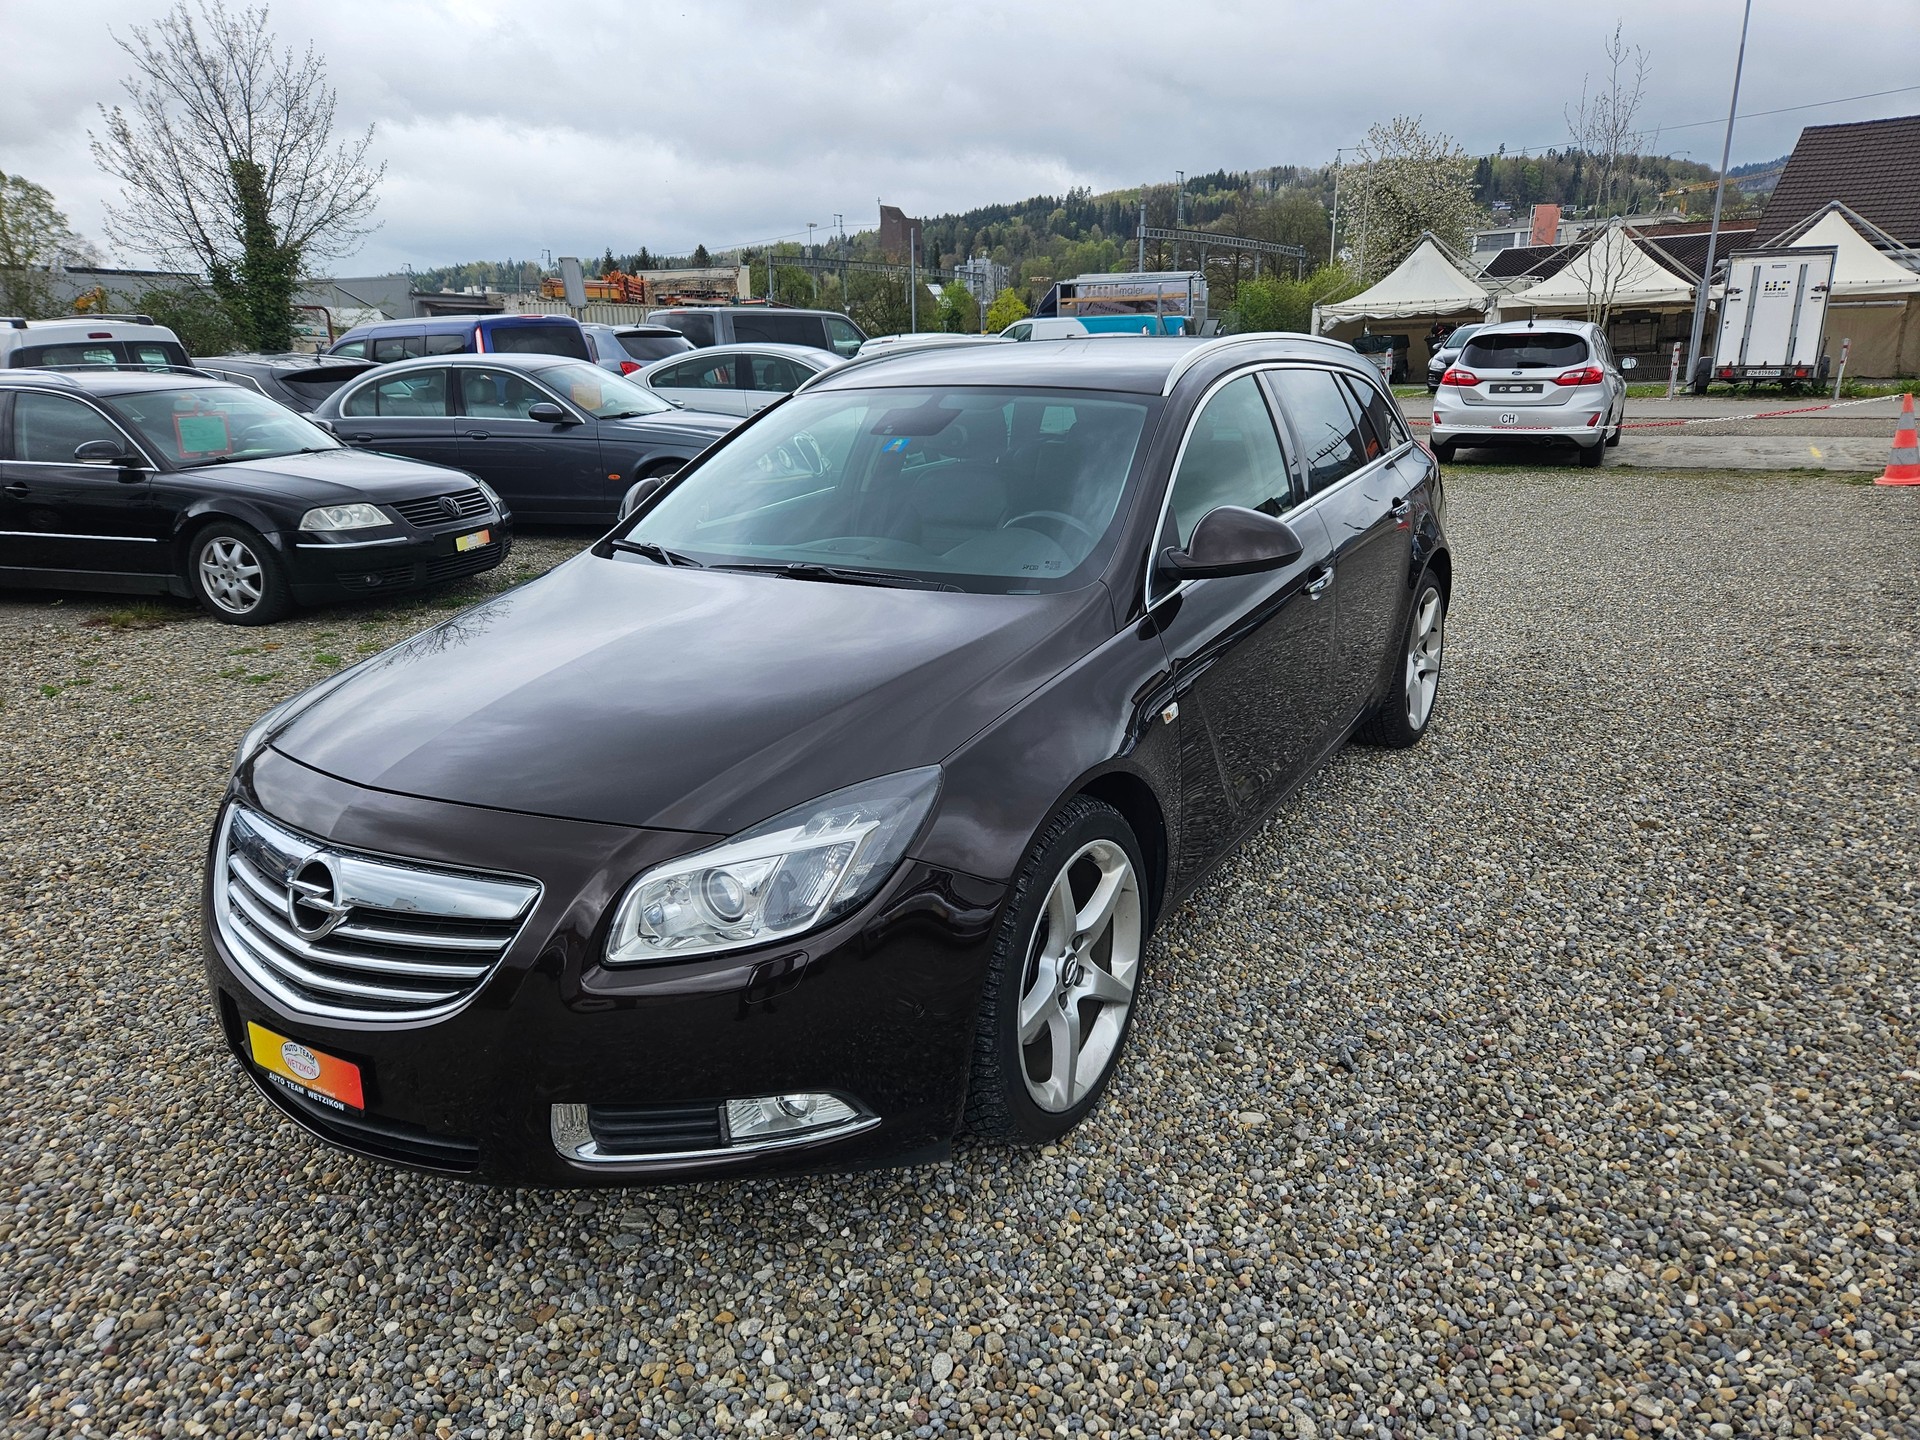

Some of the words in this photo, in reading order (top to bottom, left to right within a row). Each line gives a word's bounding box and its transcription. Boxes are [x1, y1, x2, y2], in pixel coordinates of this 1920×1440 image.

[1119, 284, 1145, 295] maler
[1501, 414, 1515, 424] CH
[284, 1043, 298, 1052] AUTO
[299, 1046, 316, 1061] TEAM
[286, 1057, 317, 1077] WETZIKON
[268, 1072, 285, 1085] AUTO
[286, 1080, 305, 1095] TEAM
[307, 1090, 345, 1111] WETZIKON
